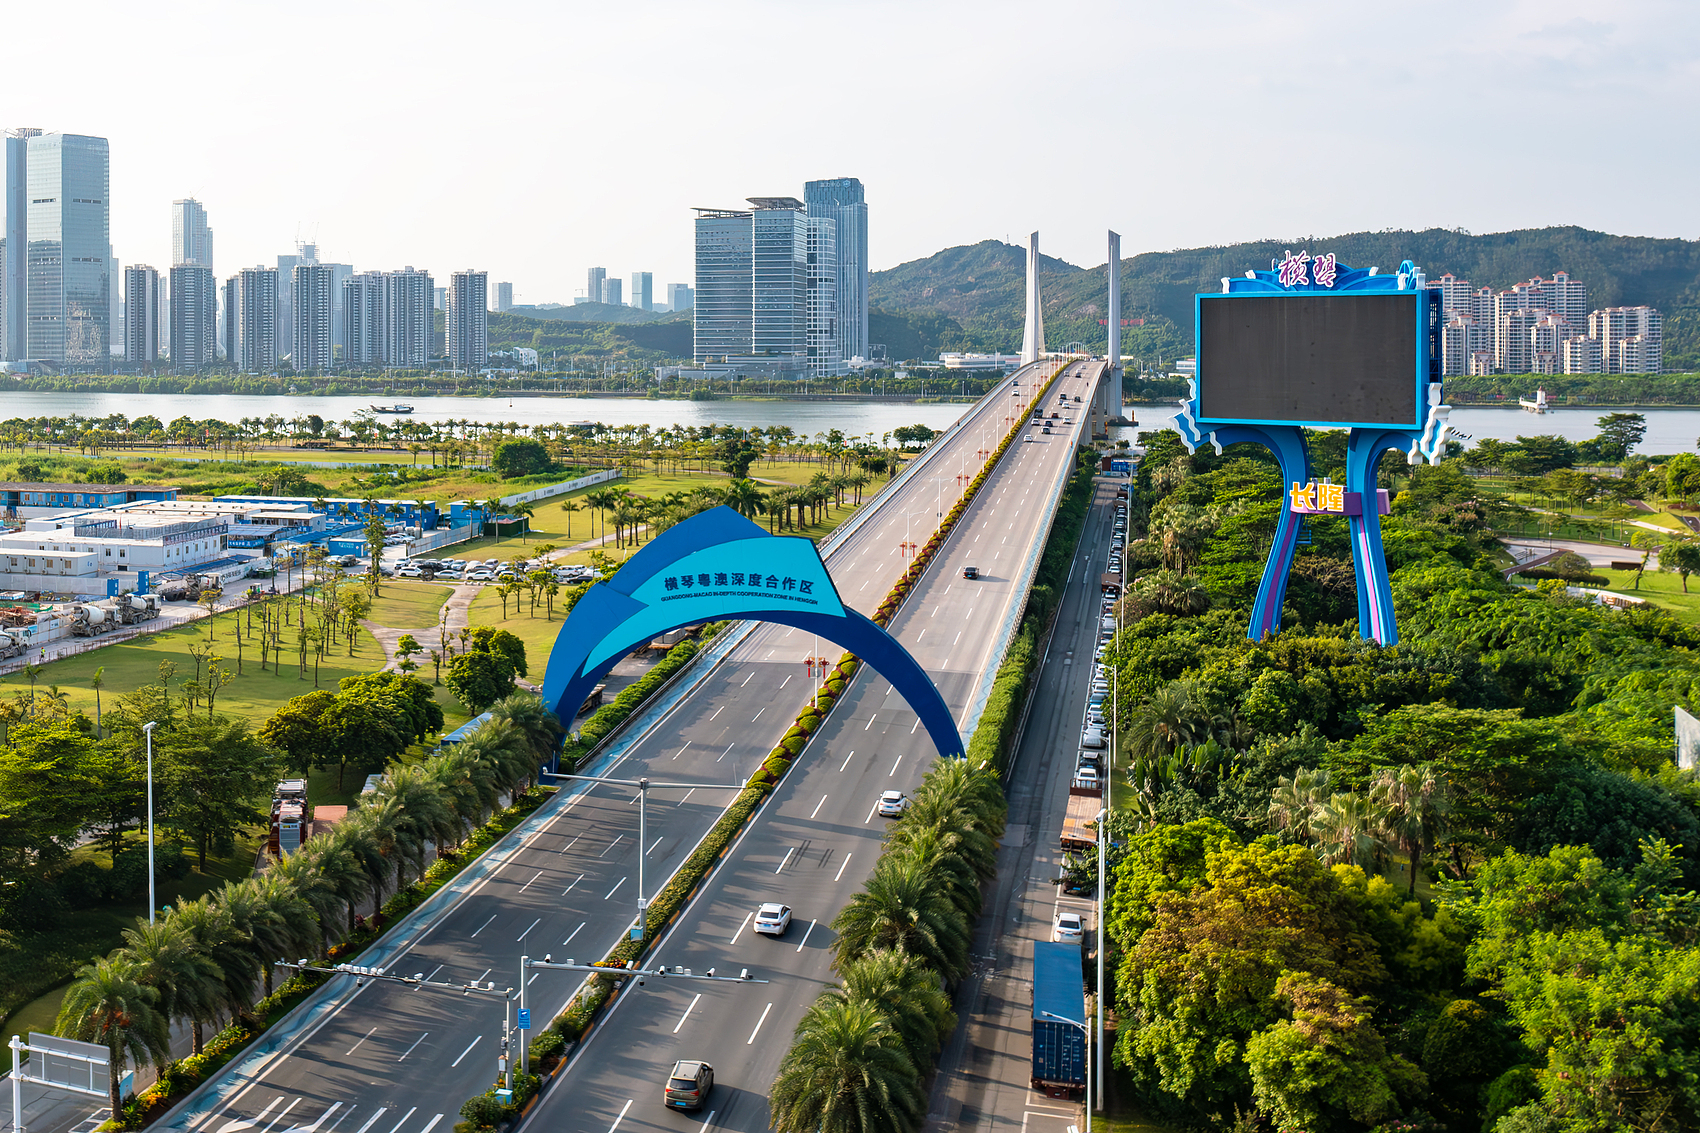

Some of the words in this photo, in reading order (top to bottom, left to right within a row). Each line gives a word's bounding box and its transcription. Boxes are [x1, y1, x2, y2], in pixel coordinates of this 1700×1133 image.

[1278, 250, 1336, 287] 横琴
[1289, 482, 1344, 512] 长隆
[664, 572, 814, 595] 横琴粤澳深度合作区
[660, 591, 713, 602] GUANGDONG-MACAO
[794, 596, 819, 605] HENGQIN
